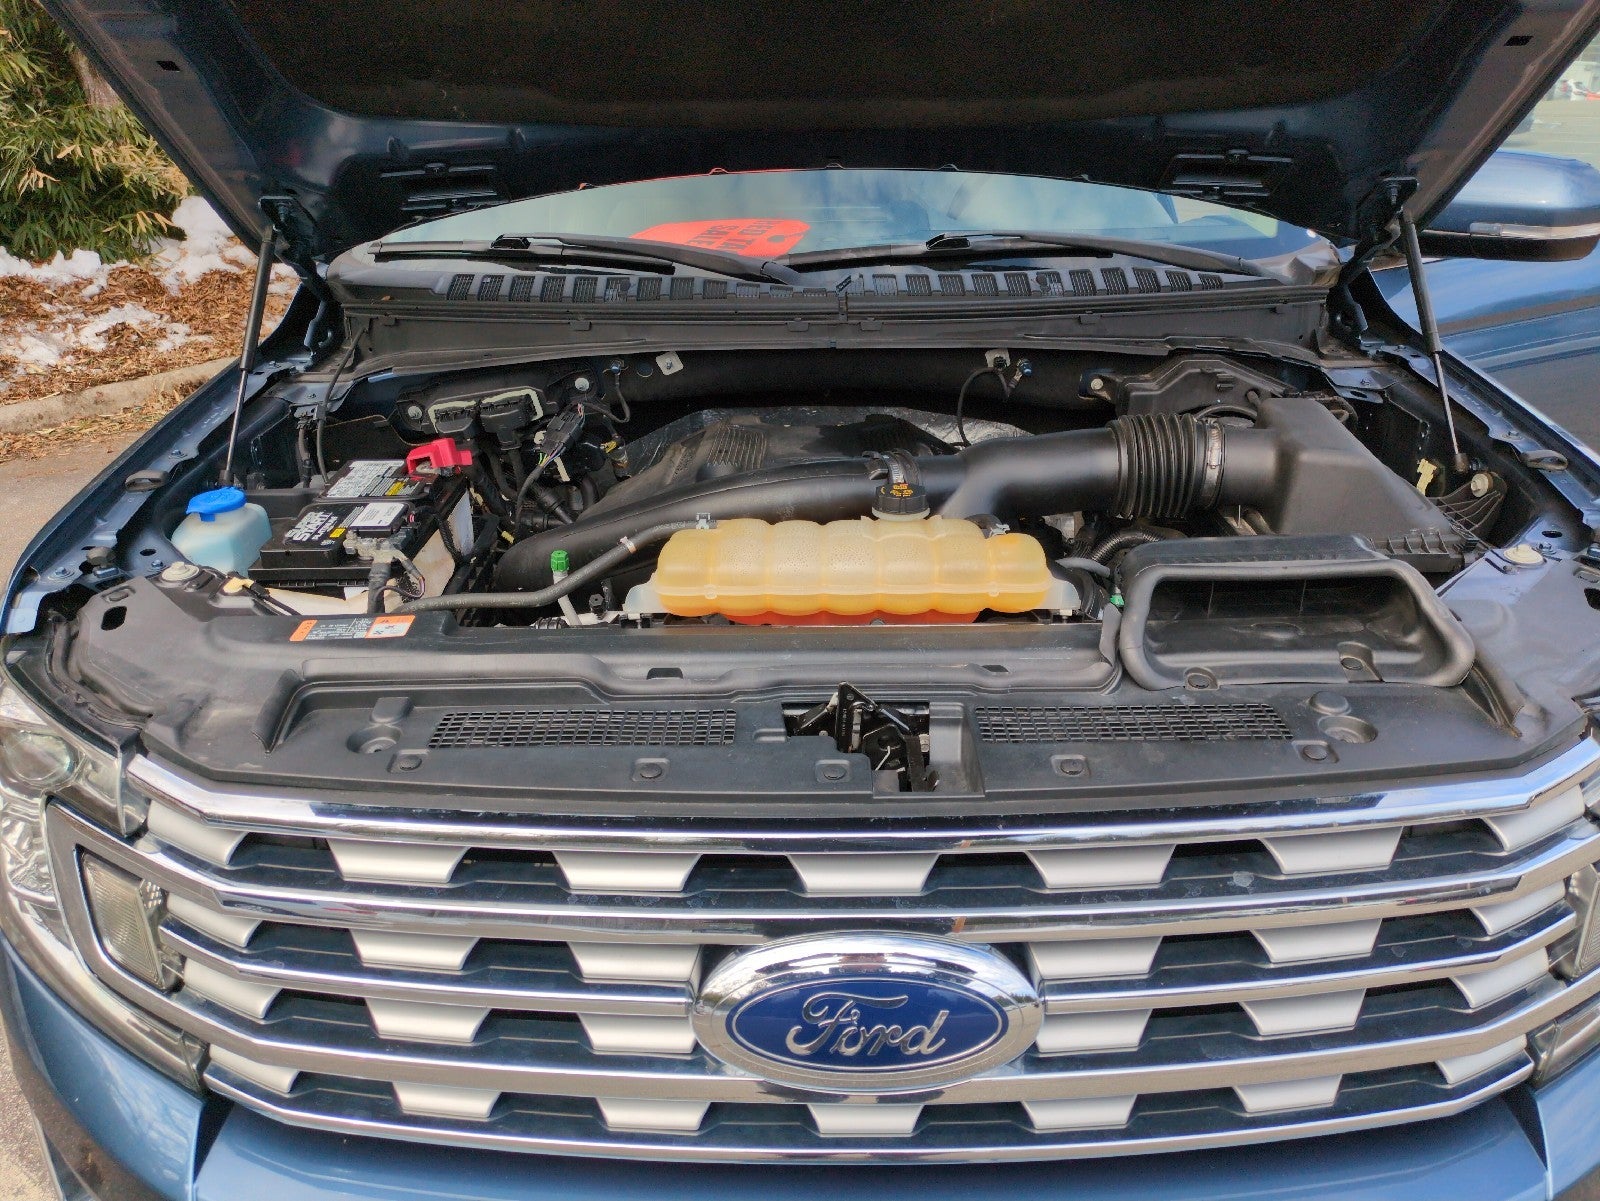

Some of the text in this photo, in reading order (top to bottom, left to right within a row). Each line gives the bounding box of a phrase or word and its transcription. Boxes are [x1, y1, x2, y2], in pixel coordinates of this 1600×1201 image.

[687, 225, 740, 246] SALE
[293, 512, 333, 542] START
[786, 991, 950, 1057] Ford
